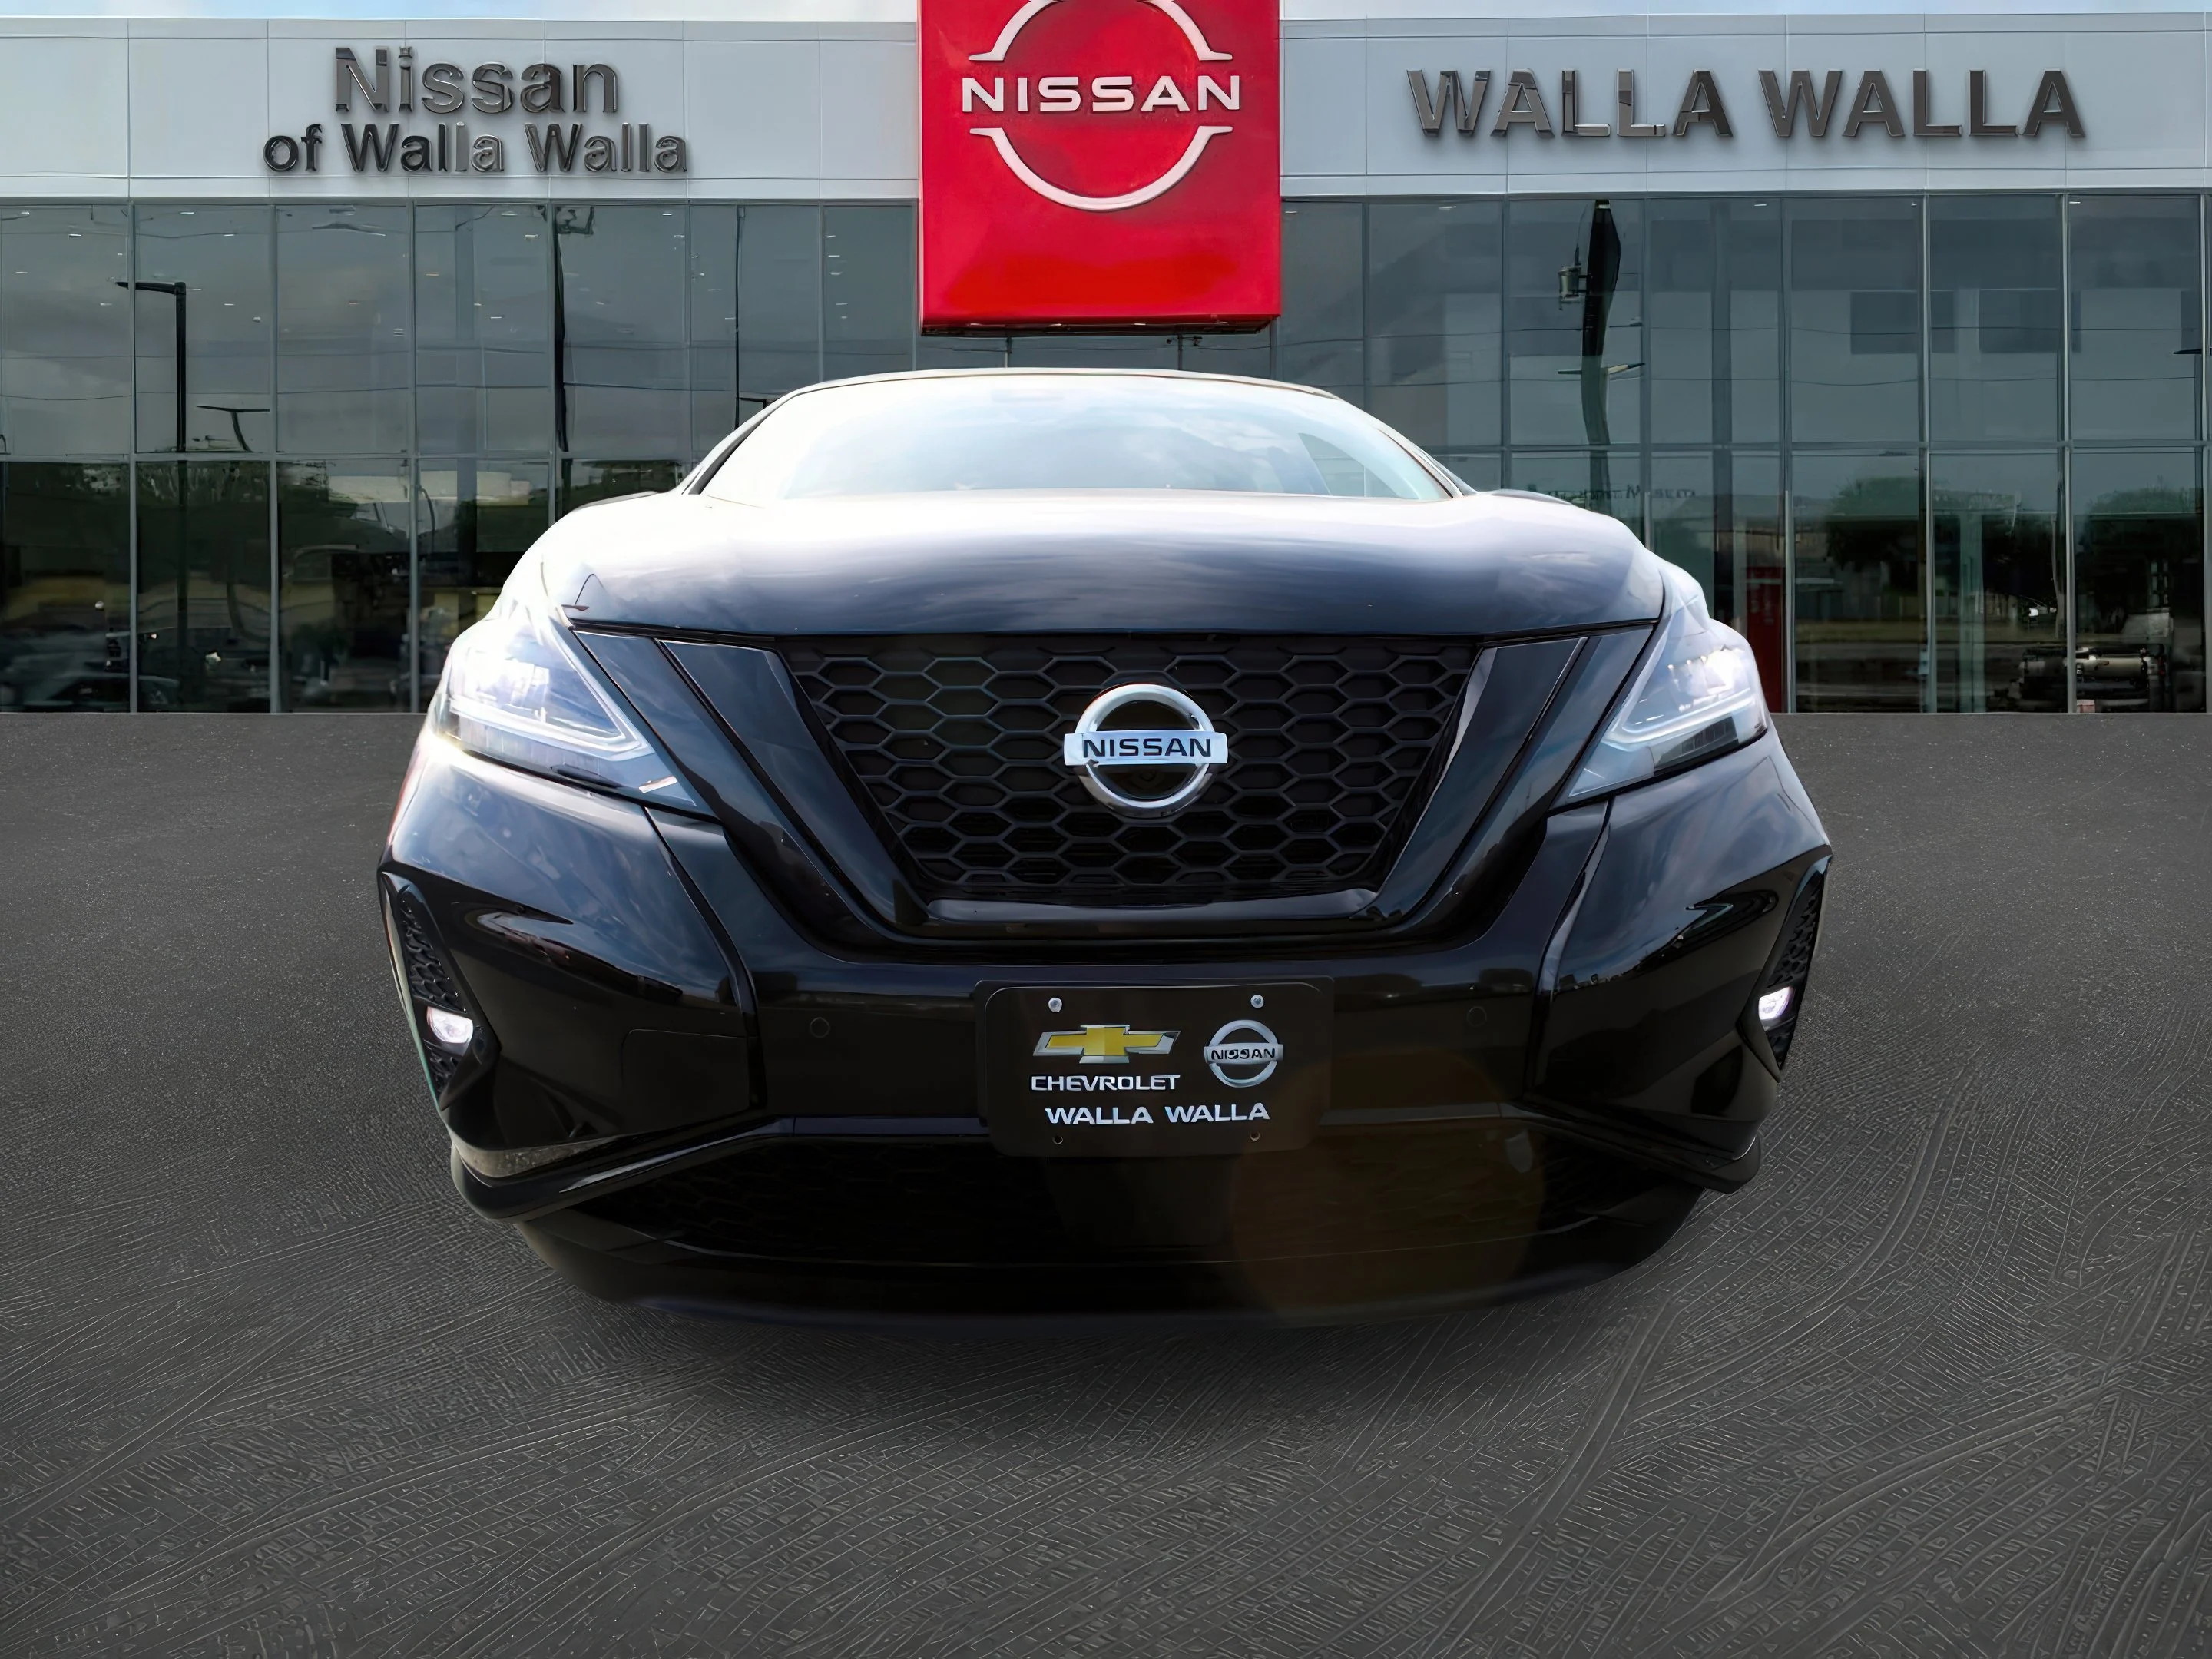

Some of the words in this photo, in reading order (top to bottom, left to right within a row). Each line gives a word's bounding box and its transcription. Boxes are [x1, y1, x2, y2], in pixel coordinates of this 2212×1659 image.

[334, 46, 618, 113] Nissan
[962, 75, 1240, 112] NISSAN
[1406, 68, 1734, 137] WALLA
[1757, 68, 2086, 137] WALLA
[263, 123, 323, 173] of
[340, 121, 505, 173] Walla
[523, 121, 687, 173] Walla
[1083, 737, 1212, 758] NISSAN
[1210, 1047, 1276, 1061] NISSAN
[1031, 1074, 1181, 1091] CHEVROLET
[1045, 1105, 1154, 1125] WALLA
[1164, 1102, 1270, 1123] WALLA
